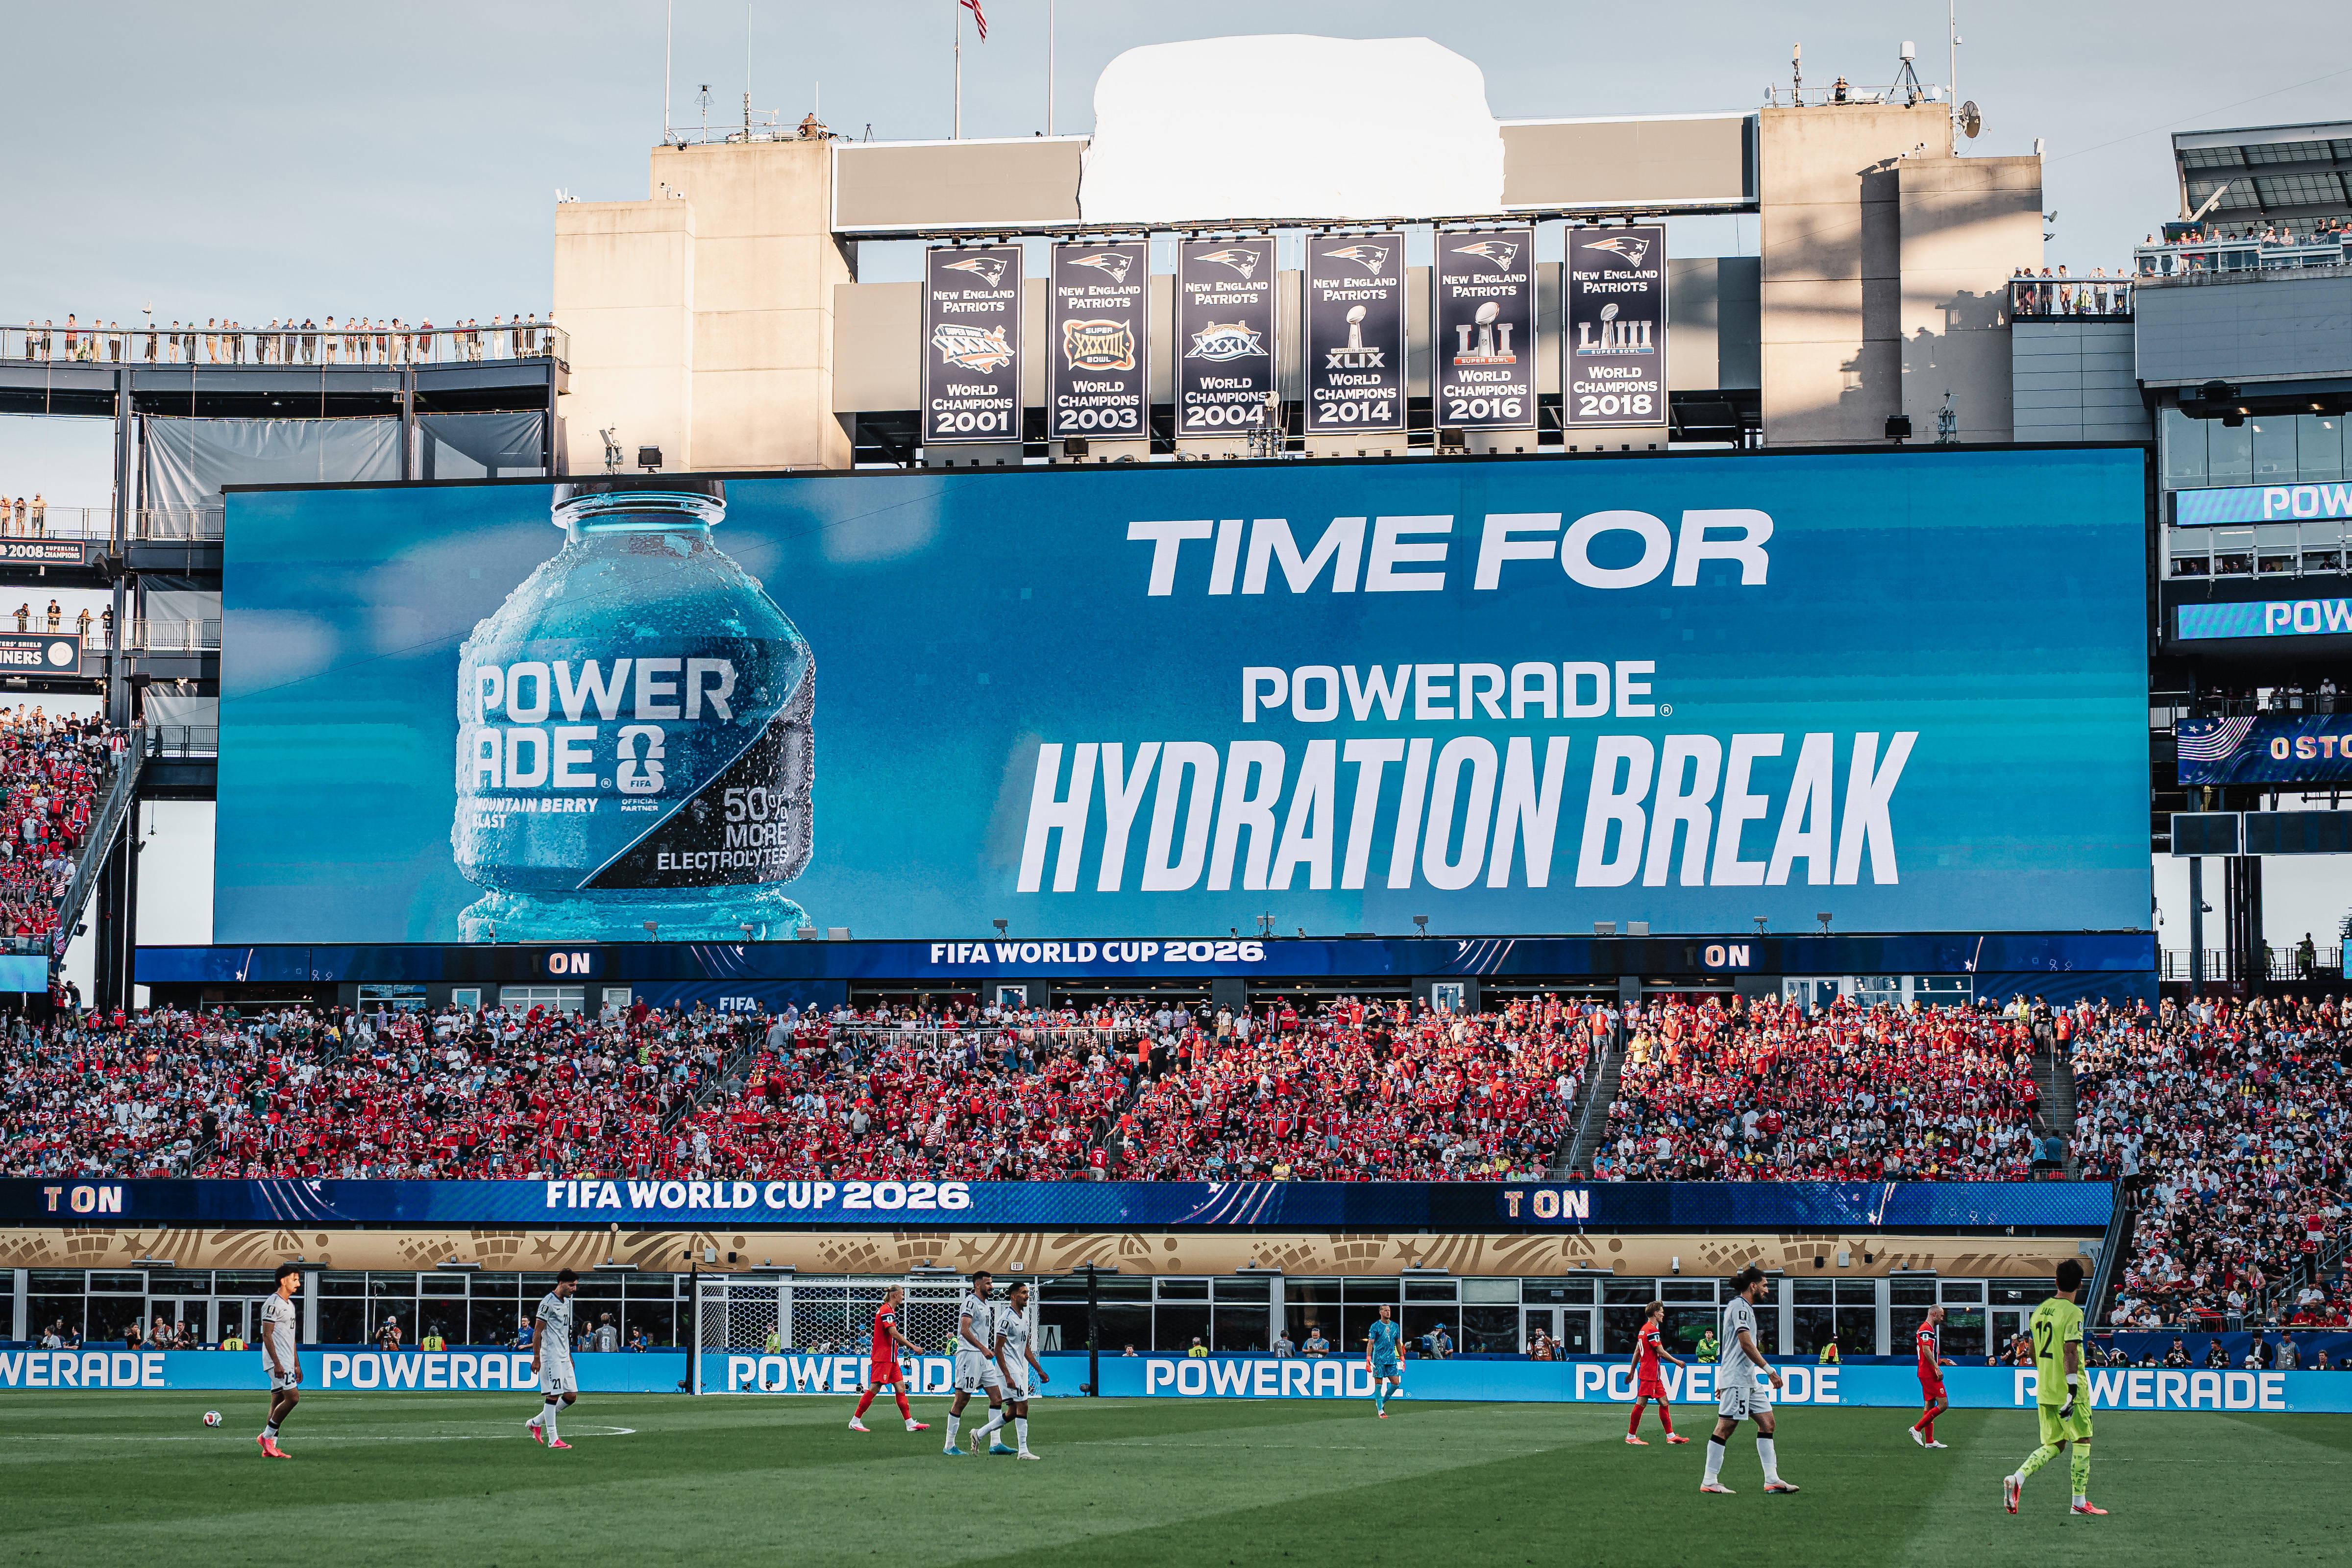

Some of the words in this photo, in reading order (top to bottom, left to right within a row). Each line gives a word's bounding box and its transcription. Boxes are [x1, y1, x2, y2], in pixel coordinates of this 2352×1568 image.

[1443, 275, 1469, 285] NEW
[1473, 274, 1526, 284] ENGLAND
[1573, 271, 1599, 281] NEW
[1603, 270, 1658, 281] ENGLAND
[1185, 283, 1211, 293] NEW
[1216, 282, 1268, 292] ENGLAND
[1313, 279, 1339, 289] NEW
[1344, 278, 1396, 288] ENGLAND
[1583, 282, 1648, 294] PATRIOTS
[933, 290, 959, 300] NEW
[963, 289, 1015, 300] ENGLAND
[1059, 286, 1084, 296] NEW
[1088, 285, 1140, 296] ENGLAND
[1323, 290, 1387, 301] PATRIOTS
[1453, 286, 1517, 298] PATRIOTS
[1069, 297, 1131, 309] PATRIOTS
[1195, 294, 1258, 305] PATRIOTS
[943, 301, 1005, 313] PATRIOTS
[1325, 353, 1385, 368] XLIX
[1458, 370, 1511, 383] WORLD
[1588, 366, 1642, 379] WORLD
[1200, 377, 1251, 390] WORLD
[1329, 373, 1381, 386] WORLD
[947, 383, 998, 396] WORLD
[1073, 380, 1124, 393] WORLD
[1444, 385, 1527, 397] CHAMPIONS
[1573, 381, 1658, 393] CHAMPIONS
[1058, 394, 1139, 407] CHAMPIONS
[1185, 391, 1266, 403] CHAMPIONS
[1314, 388, 1396, 401] CHAMPIONS
[932, 398, 1013, 411] CHAMPIONS
[1448, 398, 1522, 419] 2016
[1579, 394, 1652, 416] 2018
[1186, 405, 1264, 427] 2004
[1319, 401, 1391, 423] 2014
[936, 411, 1008, 433] 2001
[1059, 408, 1137, 430] 2003
[2264, 485, 2352, 518] POW
[9, 545, 44, 558] 2008
[1126, 514, 1453, 596] TIME
[1474, 509, 1772, 591] FOR
[2265, 600, 2352, 634] POW
[0, 651, 42, 665] NERS
[476, 659, 737, 724] POWER
[474, 798, 537, 812] MOUNTAIN
[541, 798, 598, 812] BERRY
[724, 787, 788, 822] 50%
[1016, 736, 1569, 892] HYDRATION
[1576, 732, 1919, 886] BREAK
[473, 814, 507, 828] BLAST
[726, 823, 786, 848] MORE
[658, 848, 789, 870] ELECTROLYTES
[931, 943, 990, 963] FIFA
[995, 942, 1098, 963] WORLD
[1102, 942, 1158, 962] CUP
[1164, 941, 1264, 962] 2026
[720, 998, 757, 1010] FIFA
[2060, 1023, 2066, 1031] 6
[1520, 1089, 1526, 1100] 9
[2038, 1143, 2044, 1152] 10
[1096, 1153, 1102, 1164] 9
[546, 1181, 622, 1208] FIFA
[628, 1181, 757, 1208] WORLD
[759, 1182, 835, 1209] CUP
[843, 1182, 971, 1209] 2026
[1021, 1330, 1027, 1342] 16
[2035, 1321, 2054, 1359] 12
[322, 1353, 539, 1388] POWERAD
[284, 1372, 295, 1386] 23
[552, 1378, 562, 1390] 21
[965, 1376, 974, 1389] 18
[1015, 1385, 1024, 1397] 16
[2014, 1369, 2286, 1410] PWERADE
[1739, 1400, 1745, 1415] 5
